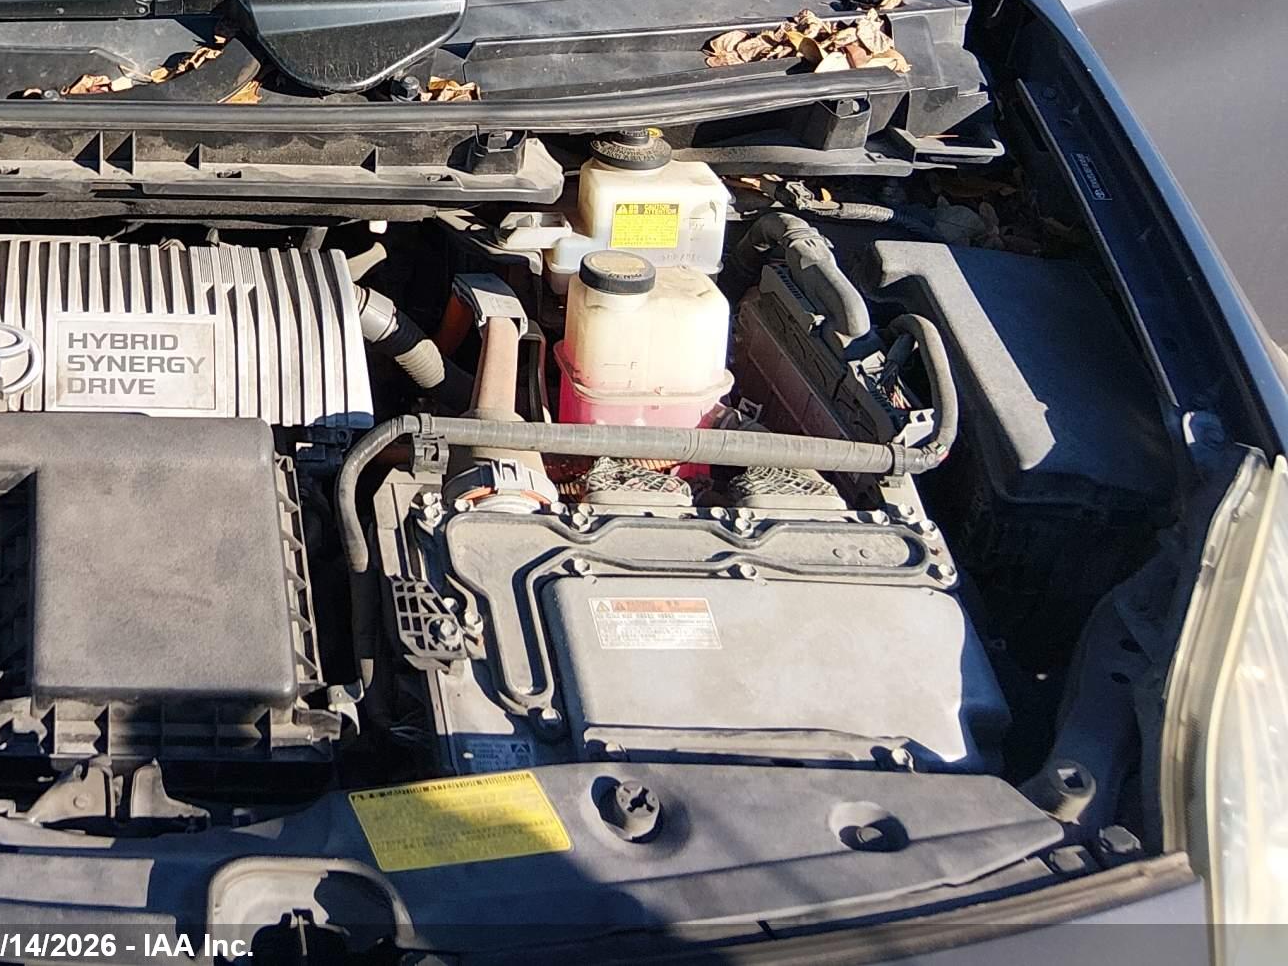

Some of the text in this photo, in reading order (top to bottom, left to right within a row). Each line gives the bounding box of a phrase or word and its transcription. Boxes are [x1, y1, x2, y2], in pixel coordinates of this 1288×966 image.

[67, 332, 178, 351] HYBRID
[67, 354, 206, 374] SYNERGY
[67, 377, 156, 395] DRIVE
